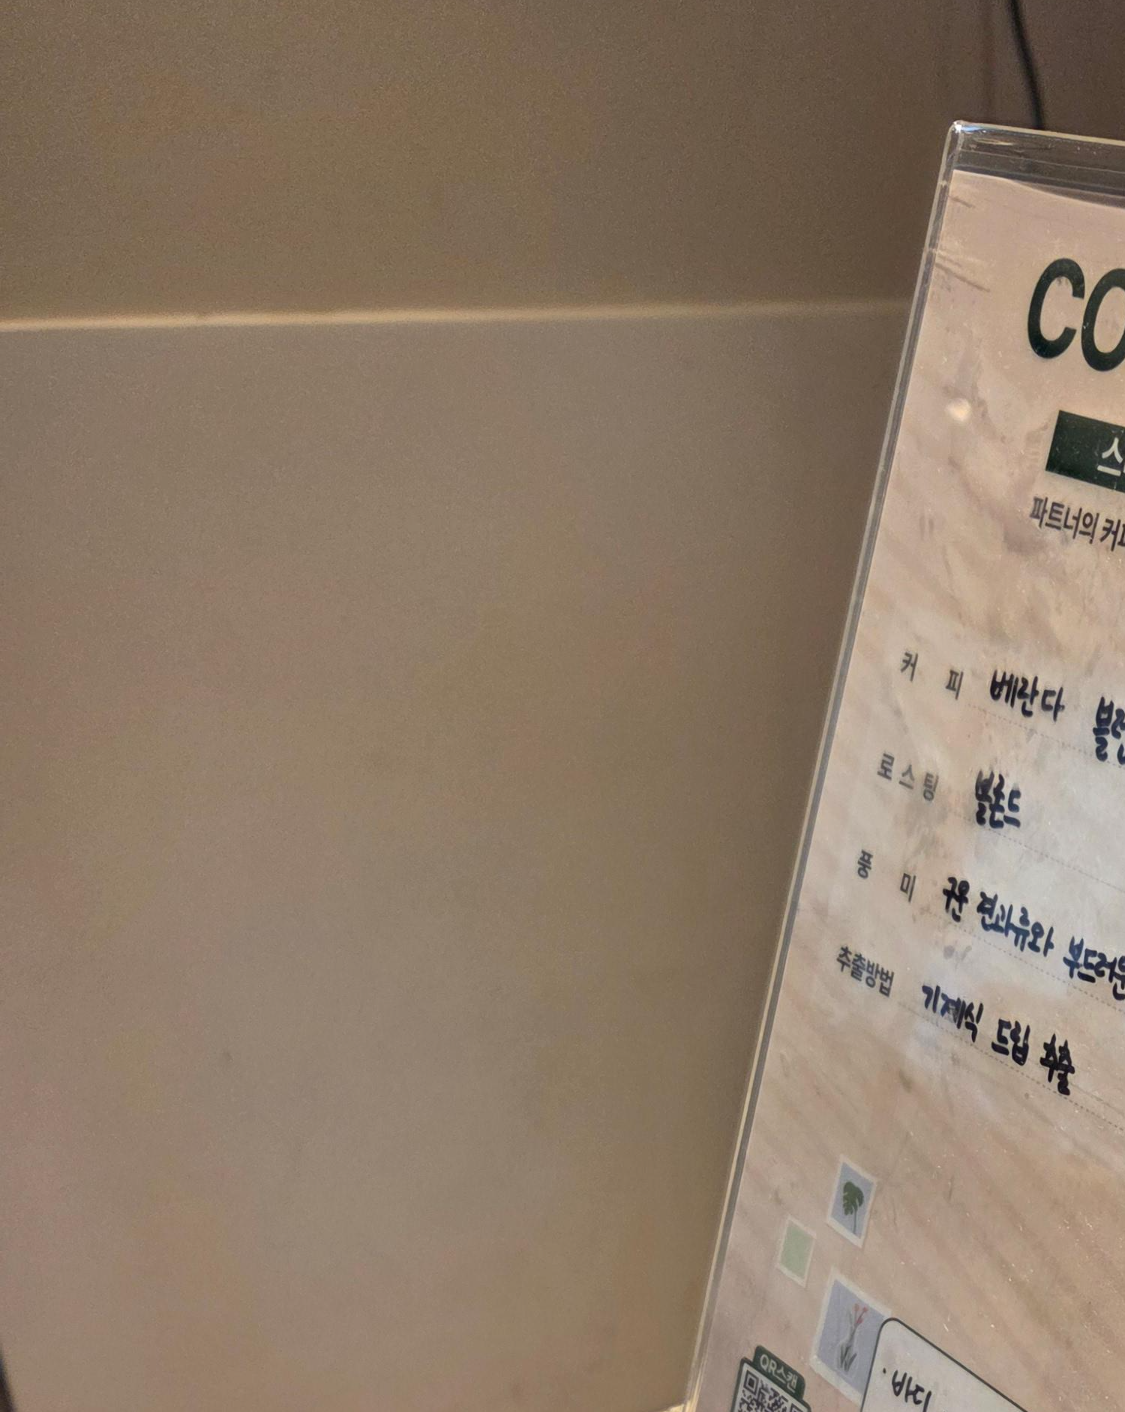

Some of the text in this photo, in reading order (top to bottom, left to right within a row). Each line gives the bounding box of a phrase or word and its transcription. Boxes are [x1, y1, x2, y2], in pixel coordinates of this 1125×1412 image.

[1029, 496, 1100, 544] 파트너의
[990, 670, 1066, 721] 베란다
[836, 946, 894, 998] 추출방법
[991, 1018, 1031, 1066] 드립
[1039, 1033, 1075, 1096] 추출
[760, 1354, 798, 1393] QR스캔
